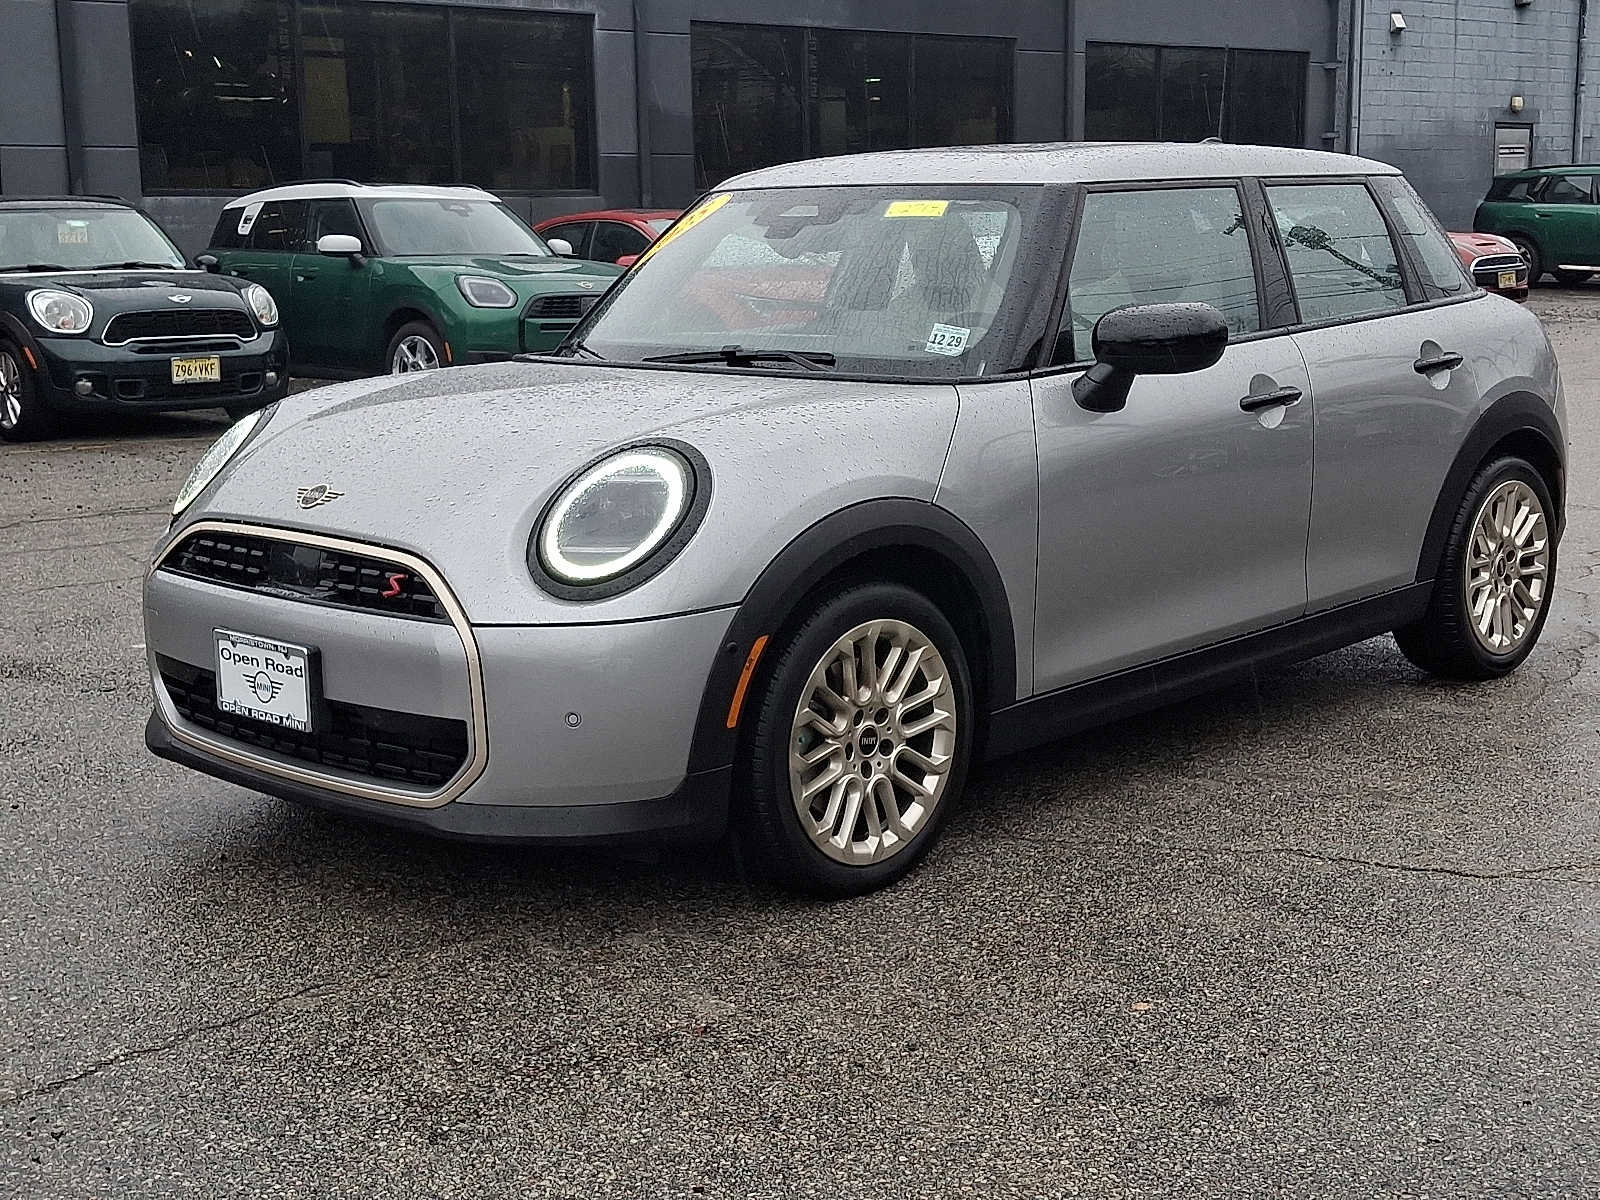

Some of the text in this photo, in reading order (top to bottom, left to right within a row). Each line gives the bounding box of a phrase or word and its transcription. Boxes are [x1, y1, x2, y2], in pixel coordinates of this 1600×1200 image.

[930, 333, 962, 347] 12 29
[174, 362, 215, 377] Z96 VKF
[382, 574, 408, 598] S
[220, 647, 303, 678] Open Road
[256, 681, 271, 693] MINI
[222, 702, 305, 730] OPEN ROAD MINI
